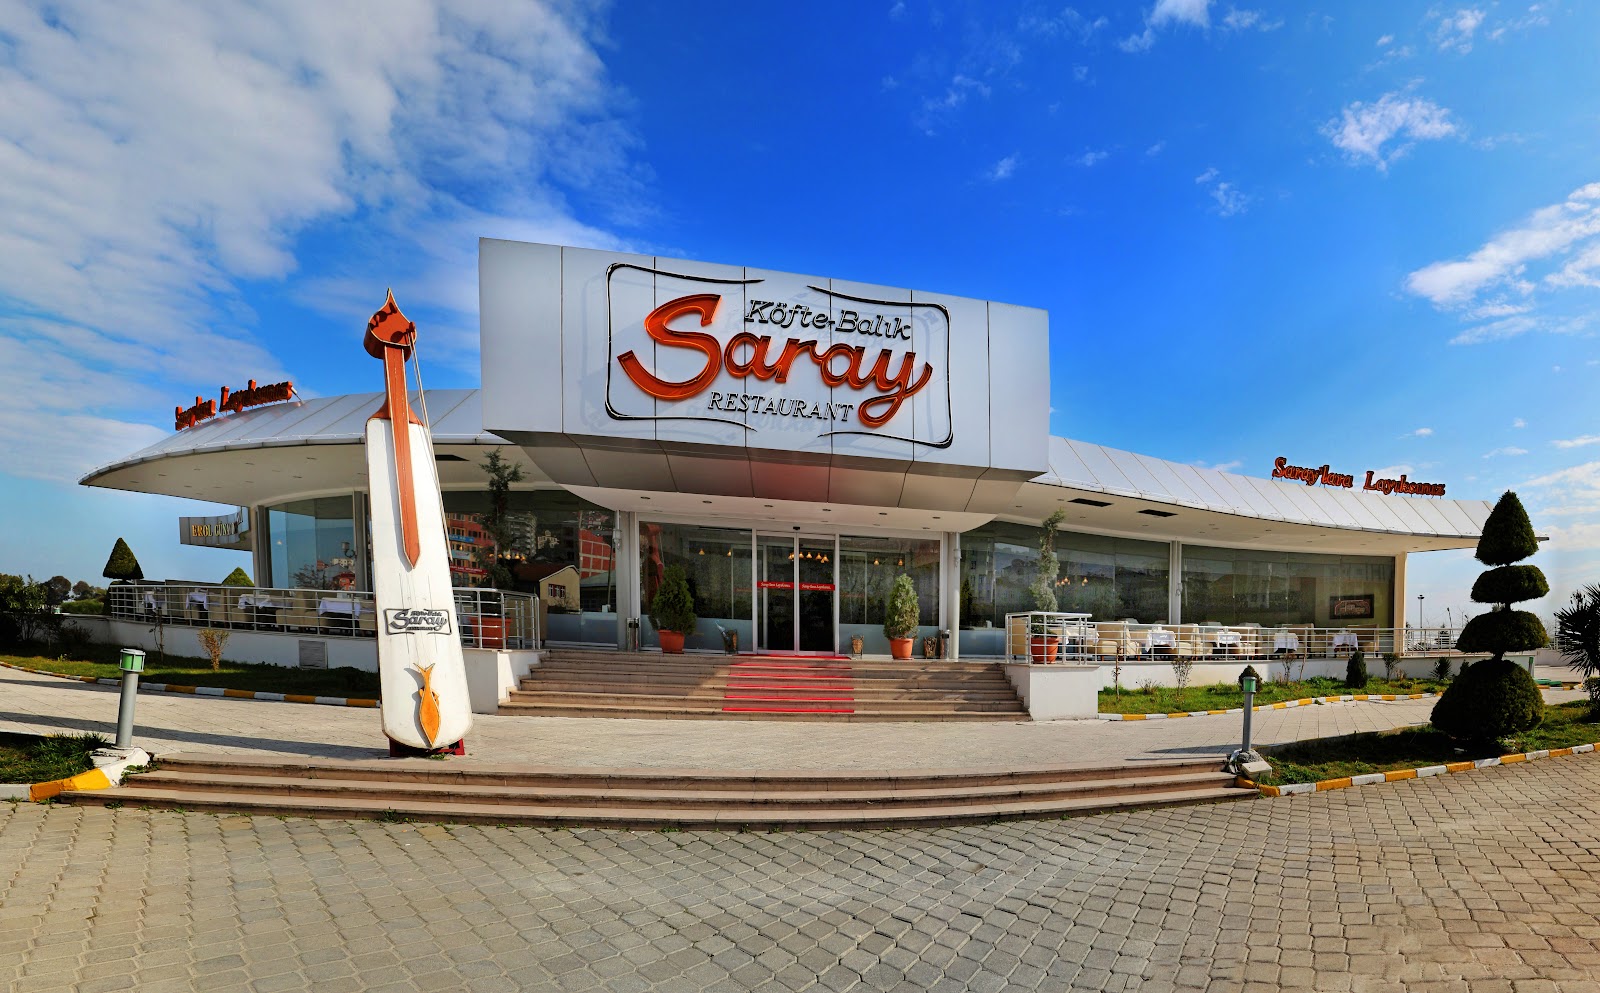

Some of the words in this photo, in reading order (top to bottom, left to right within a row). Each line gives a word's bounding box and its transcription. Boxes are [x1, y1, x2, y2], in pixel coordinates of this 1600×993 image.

[617, 294, 933, 427] Saray
[708, 391, 854, 421] RESTAURANT
[191, 524, 213, 537] EROL
[389, 604, 447, 631] Saray
